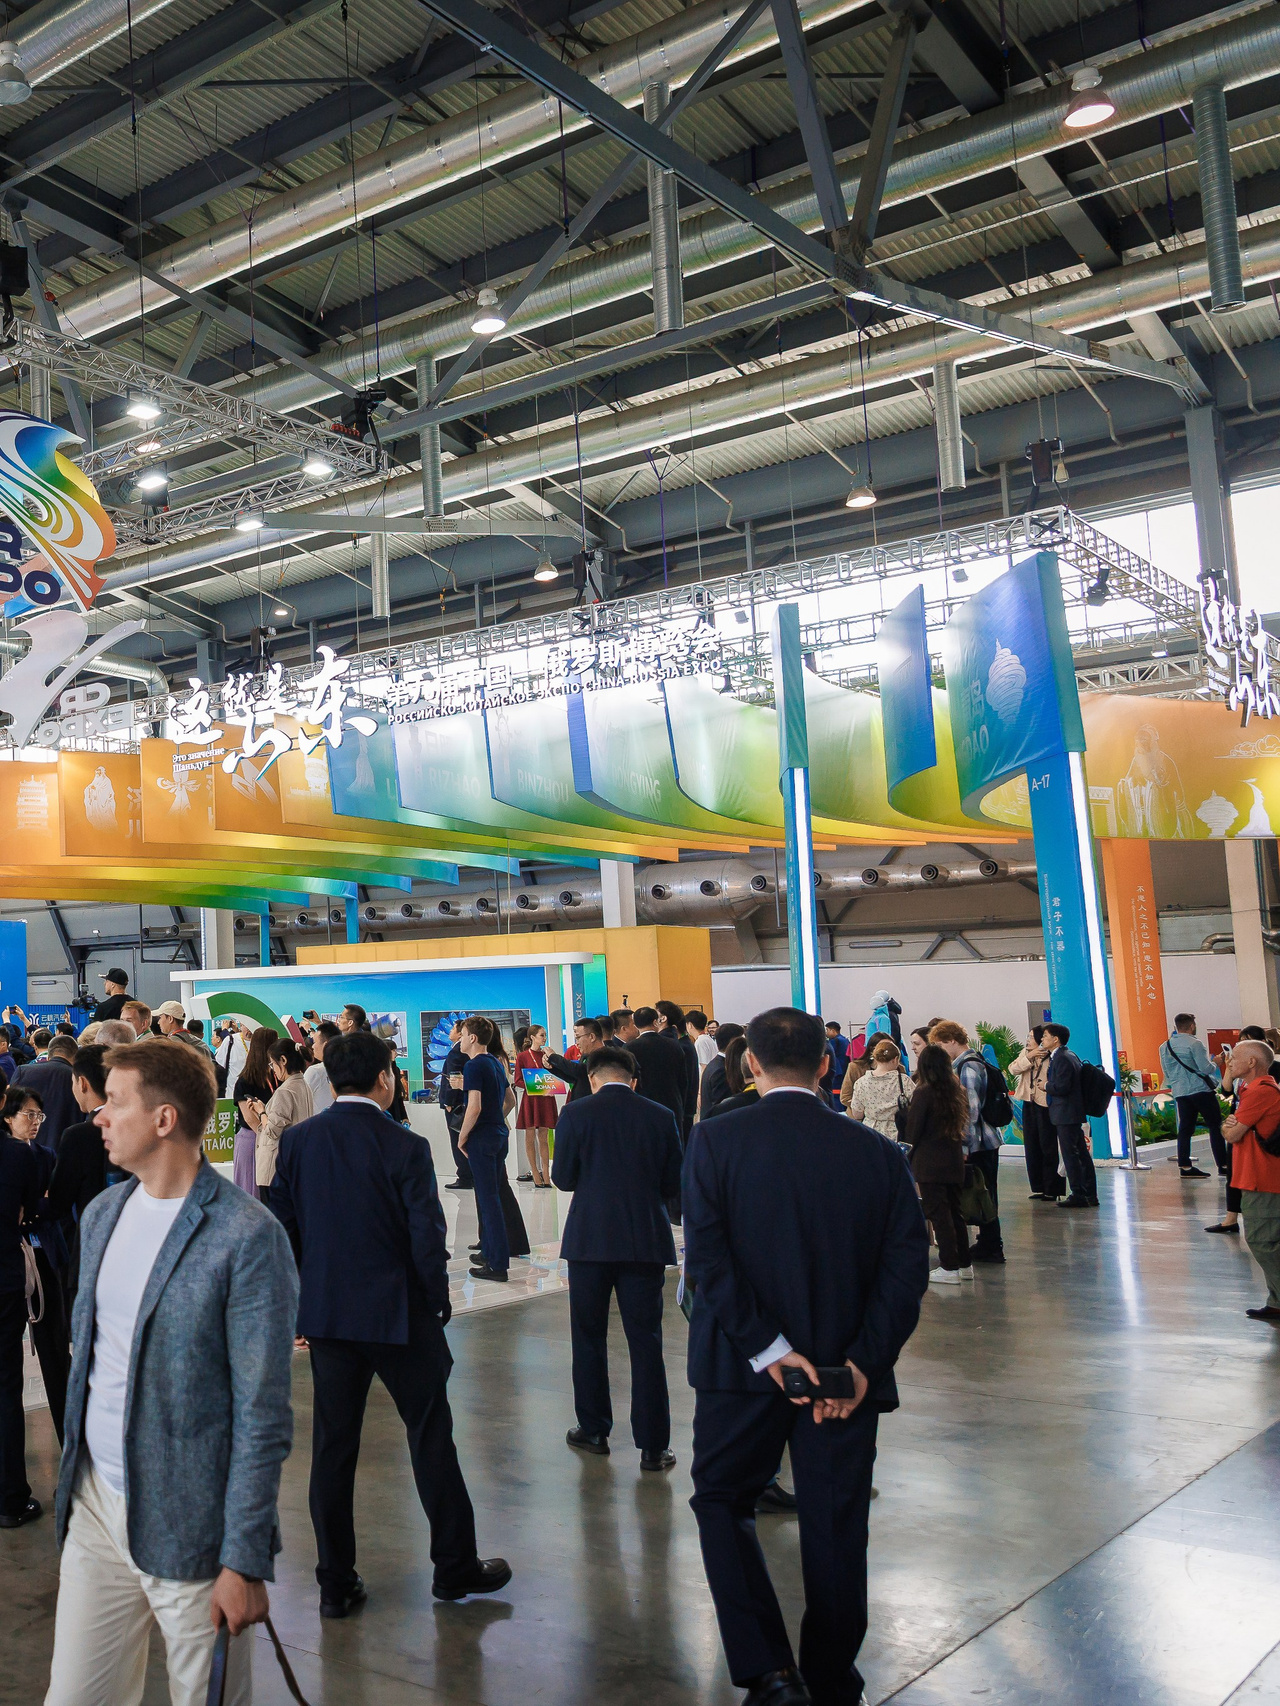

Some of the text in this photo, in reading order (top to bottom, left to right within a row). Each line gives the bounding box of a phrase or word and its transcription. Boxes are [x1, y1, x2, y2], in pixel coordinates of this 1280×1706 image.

[683, 658, 722, 677] EXPO
[172, 747, 225, 763] Это значение
[1031, 773, 1051, 792] A-17
